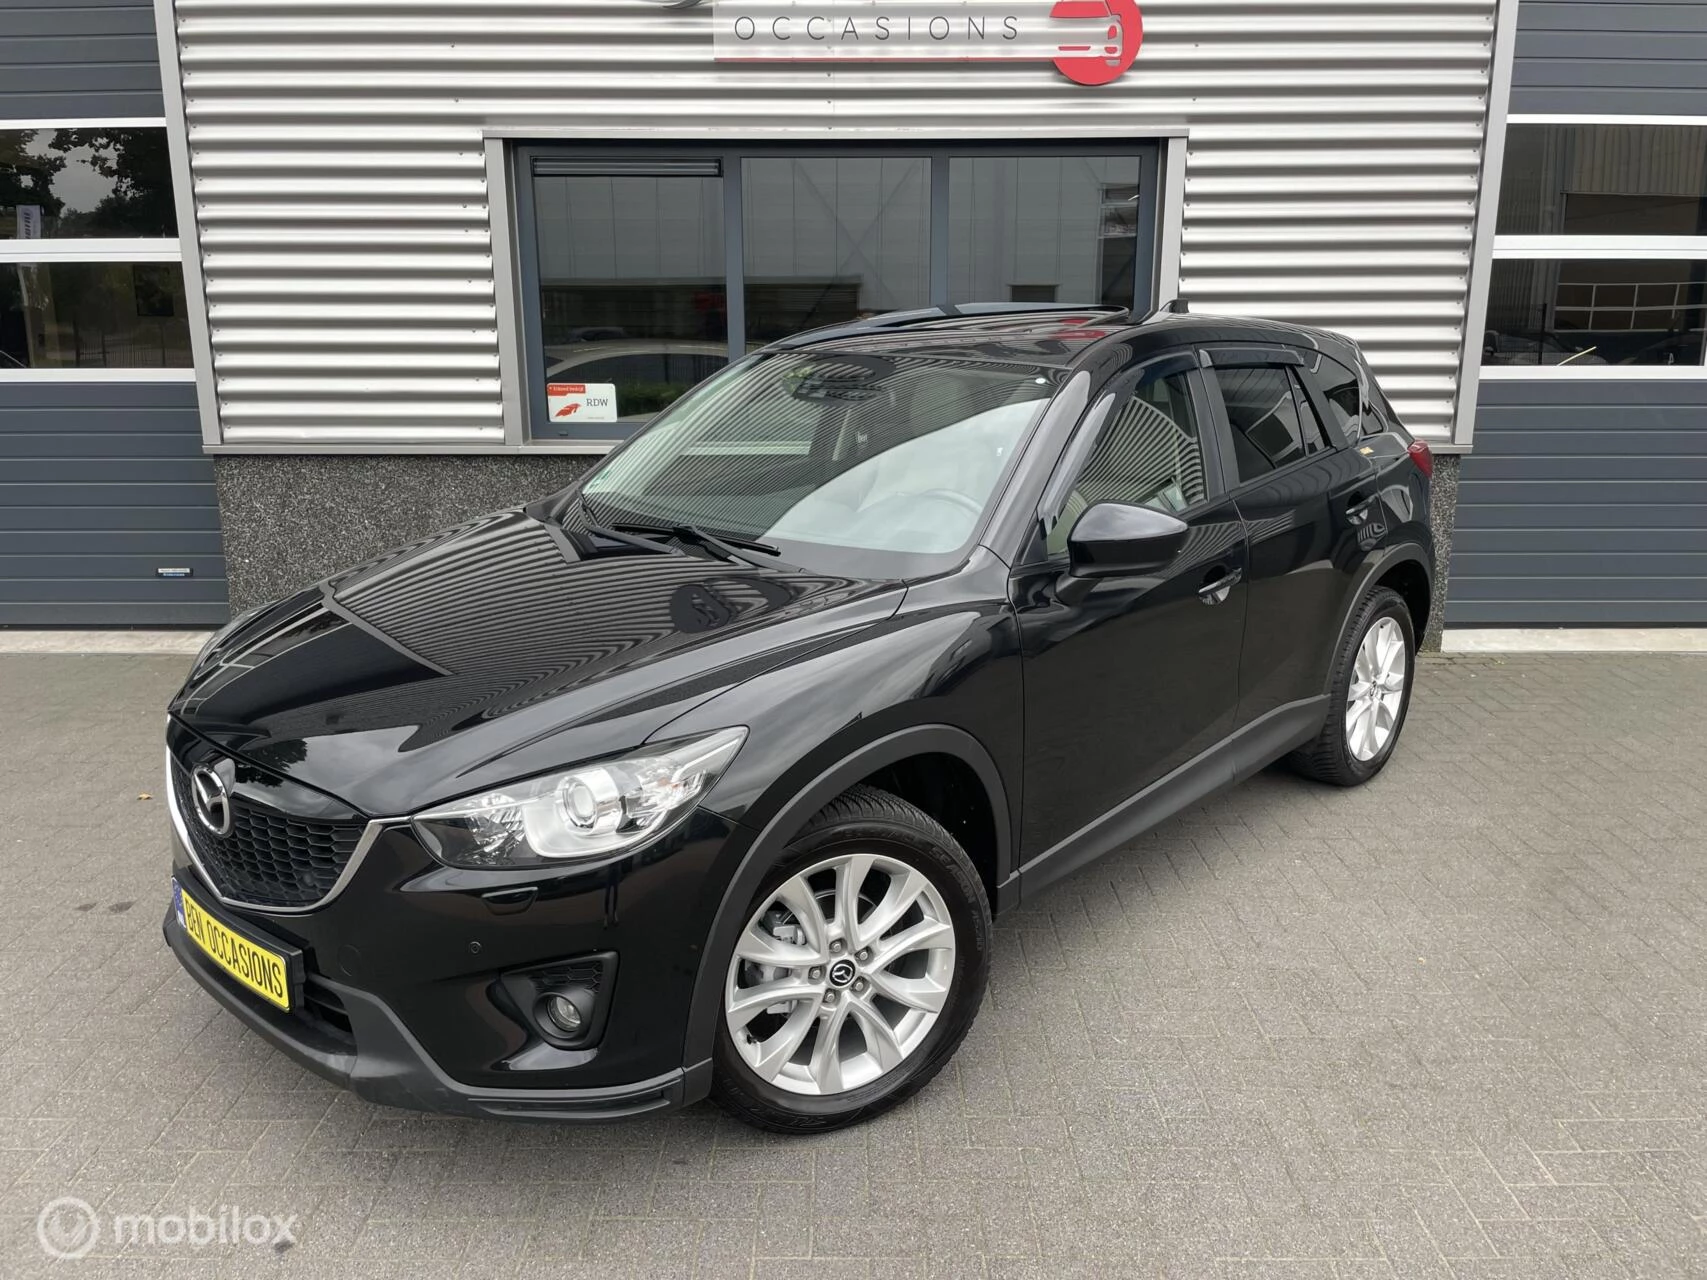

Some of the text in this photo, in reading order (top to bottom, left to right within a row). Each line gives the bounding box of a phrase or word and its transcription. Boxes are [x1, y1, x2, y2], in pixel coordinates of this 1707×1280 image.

[734, 16, 1019, 41] OCCASIONS
[586, 398, 609, 407] RDW
[184, 897, 284, 998] BEN OCCASIONS
